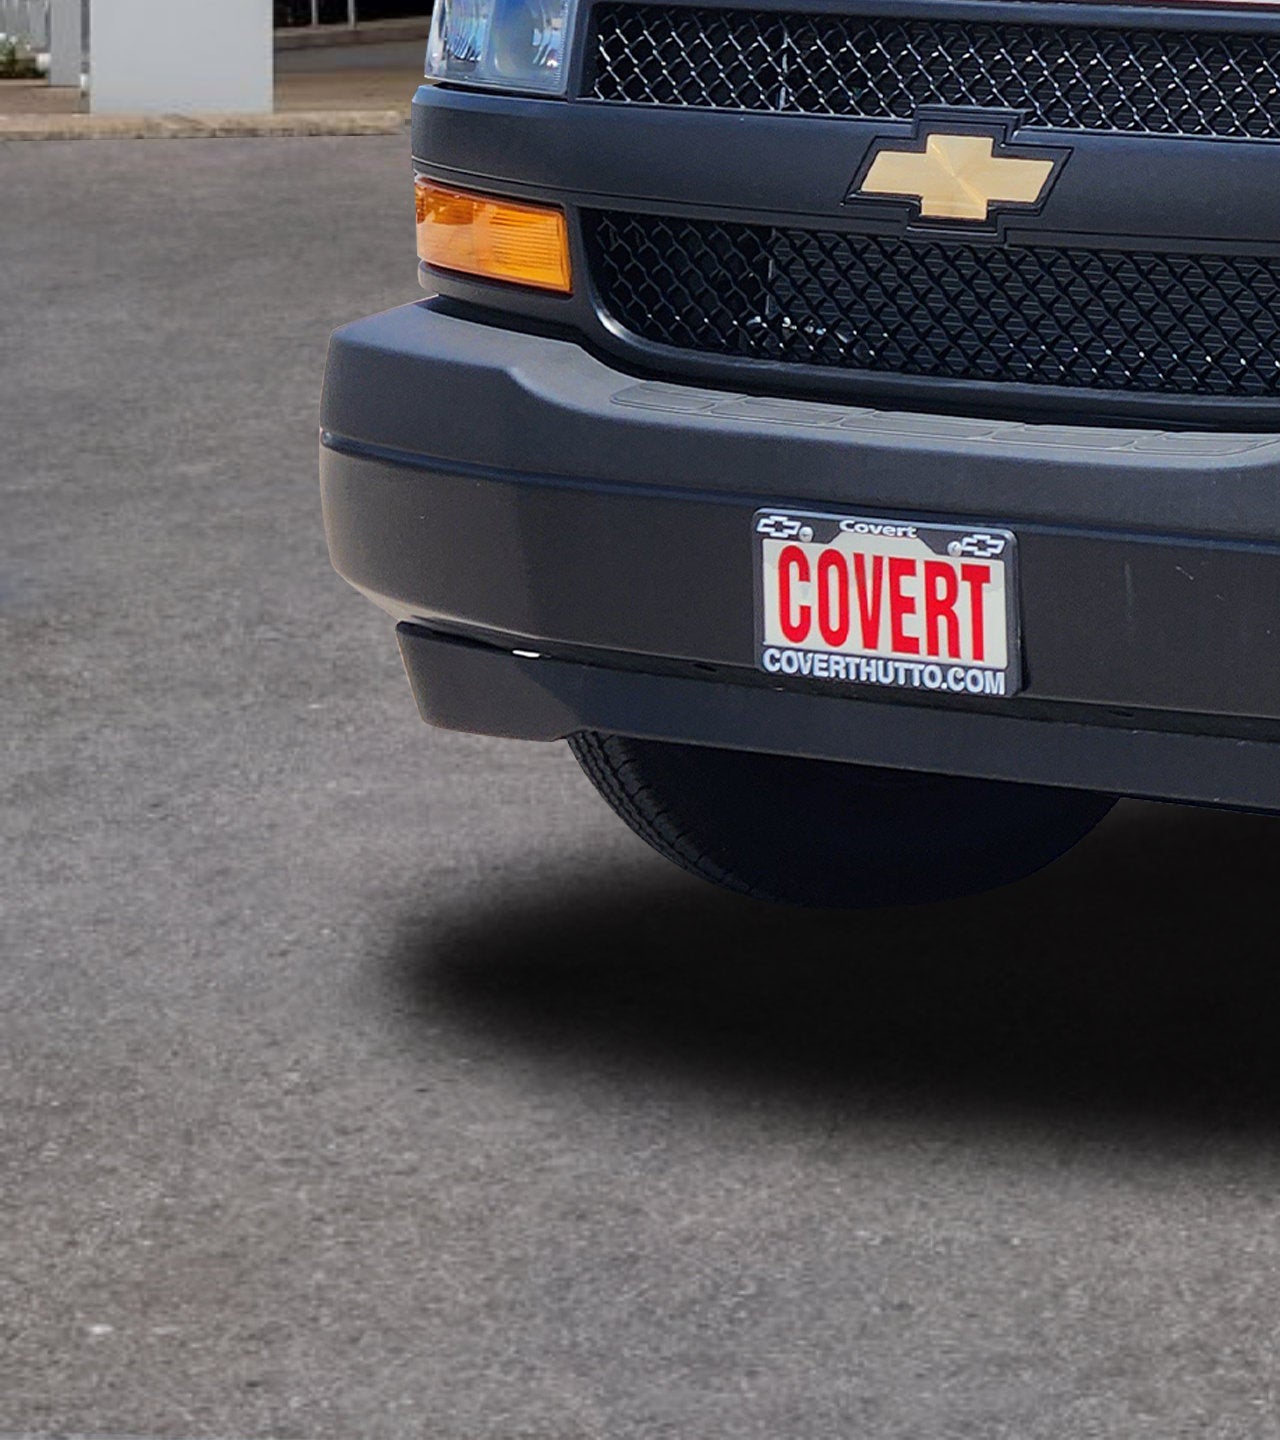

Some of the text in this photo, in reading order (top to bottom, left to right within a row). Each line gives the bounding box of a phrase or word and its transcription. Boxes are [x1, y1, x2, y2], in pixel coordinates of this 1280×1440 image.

[839, 519, 917, 538] Covert
[778, 545, 990, 661] COVERT
[763, 648, 1005, 695] COVERTHUTTO.COM
